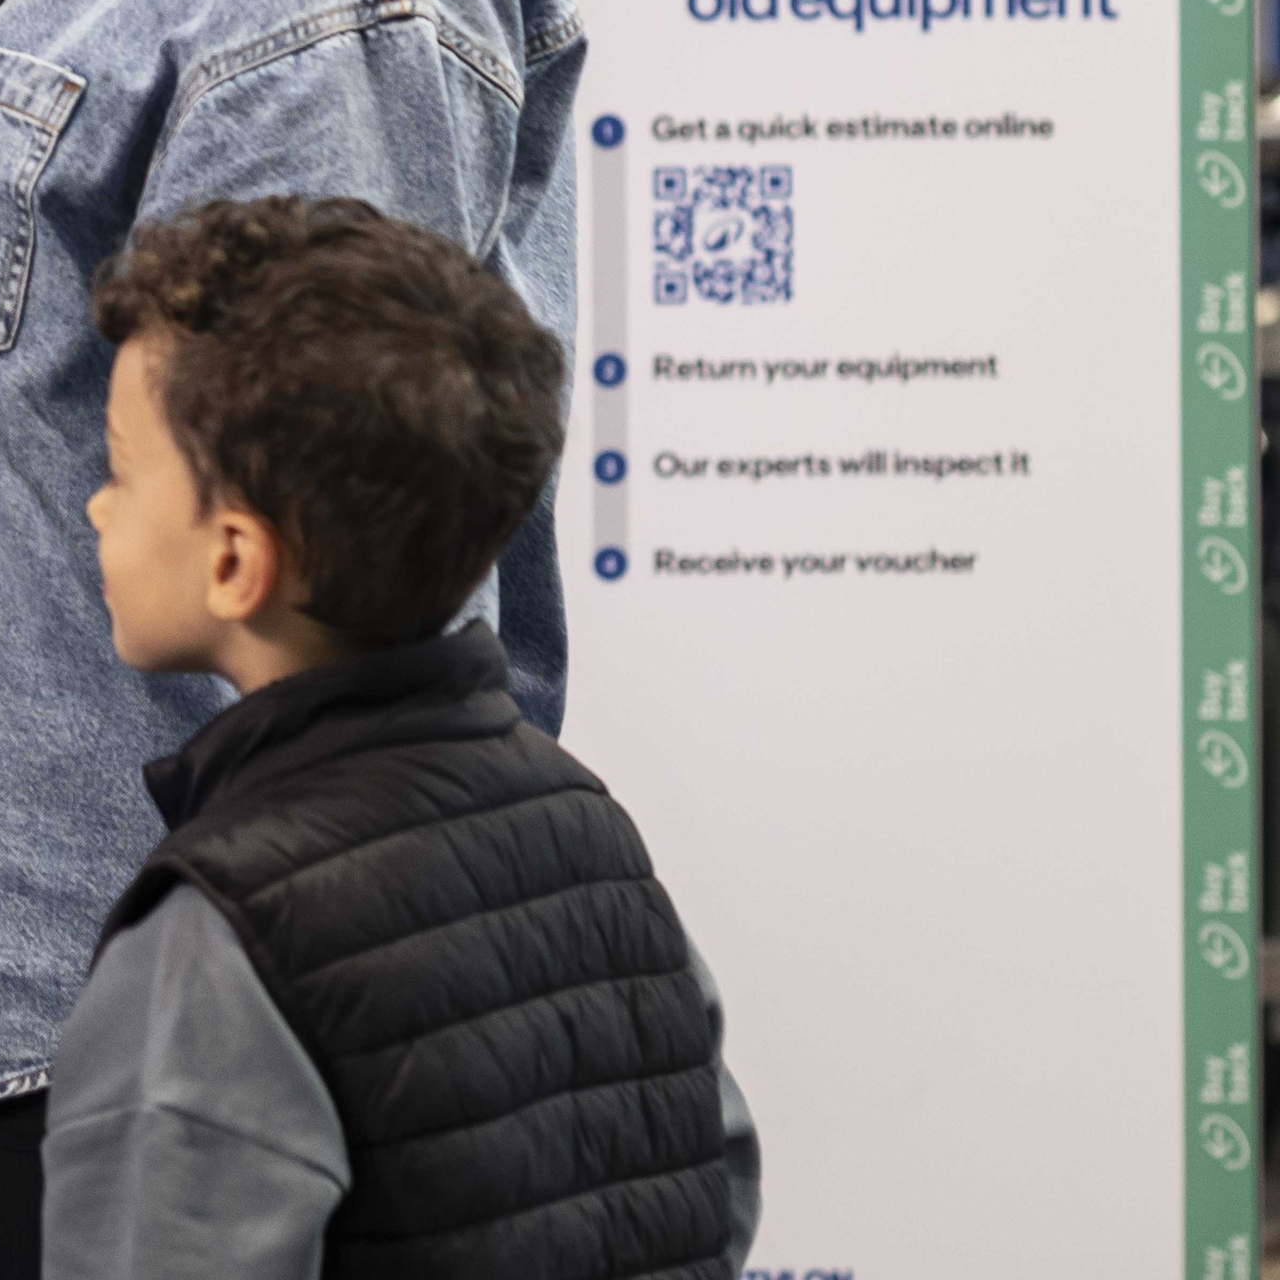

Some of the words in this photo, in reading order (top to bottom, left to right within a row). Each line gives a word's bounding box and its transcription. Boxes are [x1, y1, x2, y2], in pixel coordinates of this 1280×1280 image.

[651, 118, 708, 141] Get
[715, 124, 730, 140] a
[739, 117, 816, 145] quick
[827, 116, 958, 140] estimate
[965, 115, 1056, 139] online
[653, 355, 756, 380] Return
[765, 359, 828, 384] your
[837, 354, 998, 382] equipment
[653, 452, 708, 477] Our
[717, 453, 830, 481] experts
[840, 450, 886, 475] will
[894, 449, 1003, 480] inspect
[1011, 450, 1030, 474] it
[653, 549, 774, 575] Receive
[782, 553, 846, 579] your
[855, 548, 978, 574] voucher
